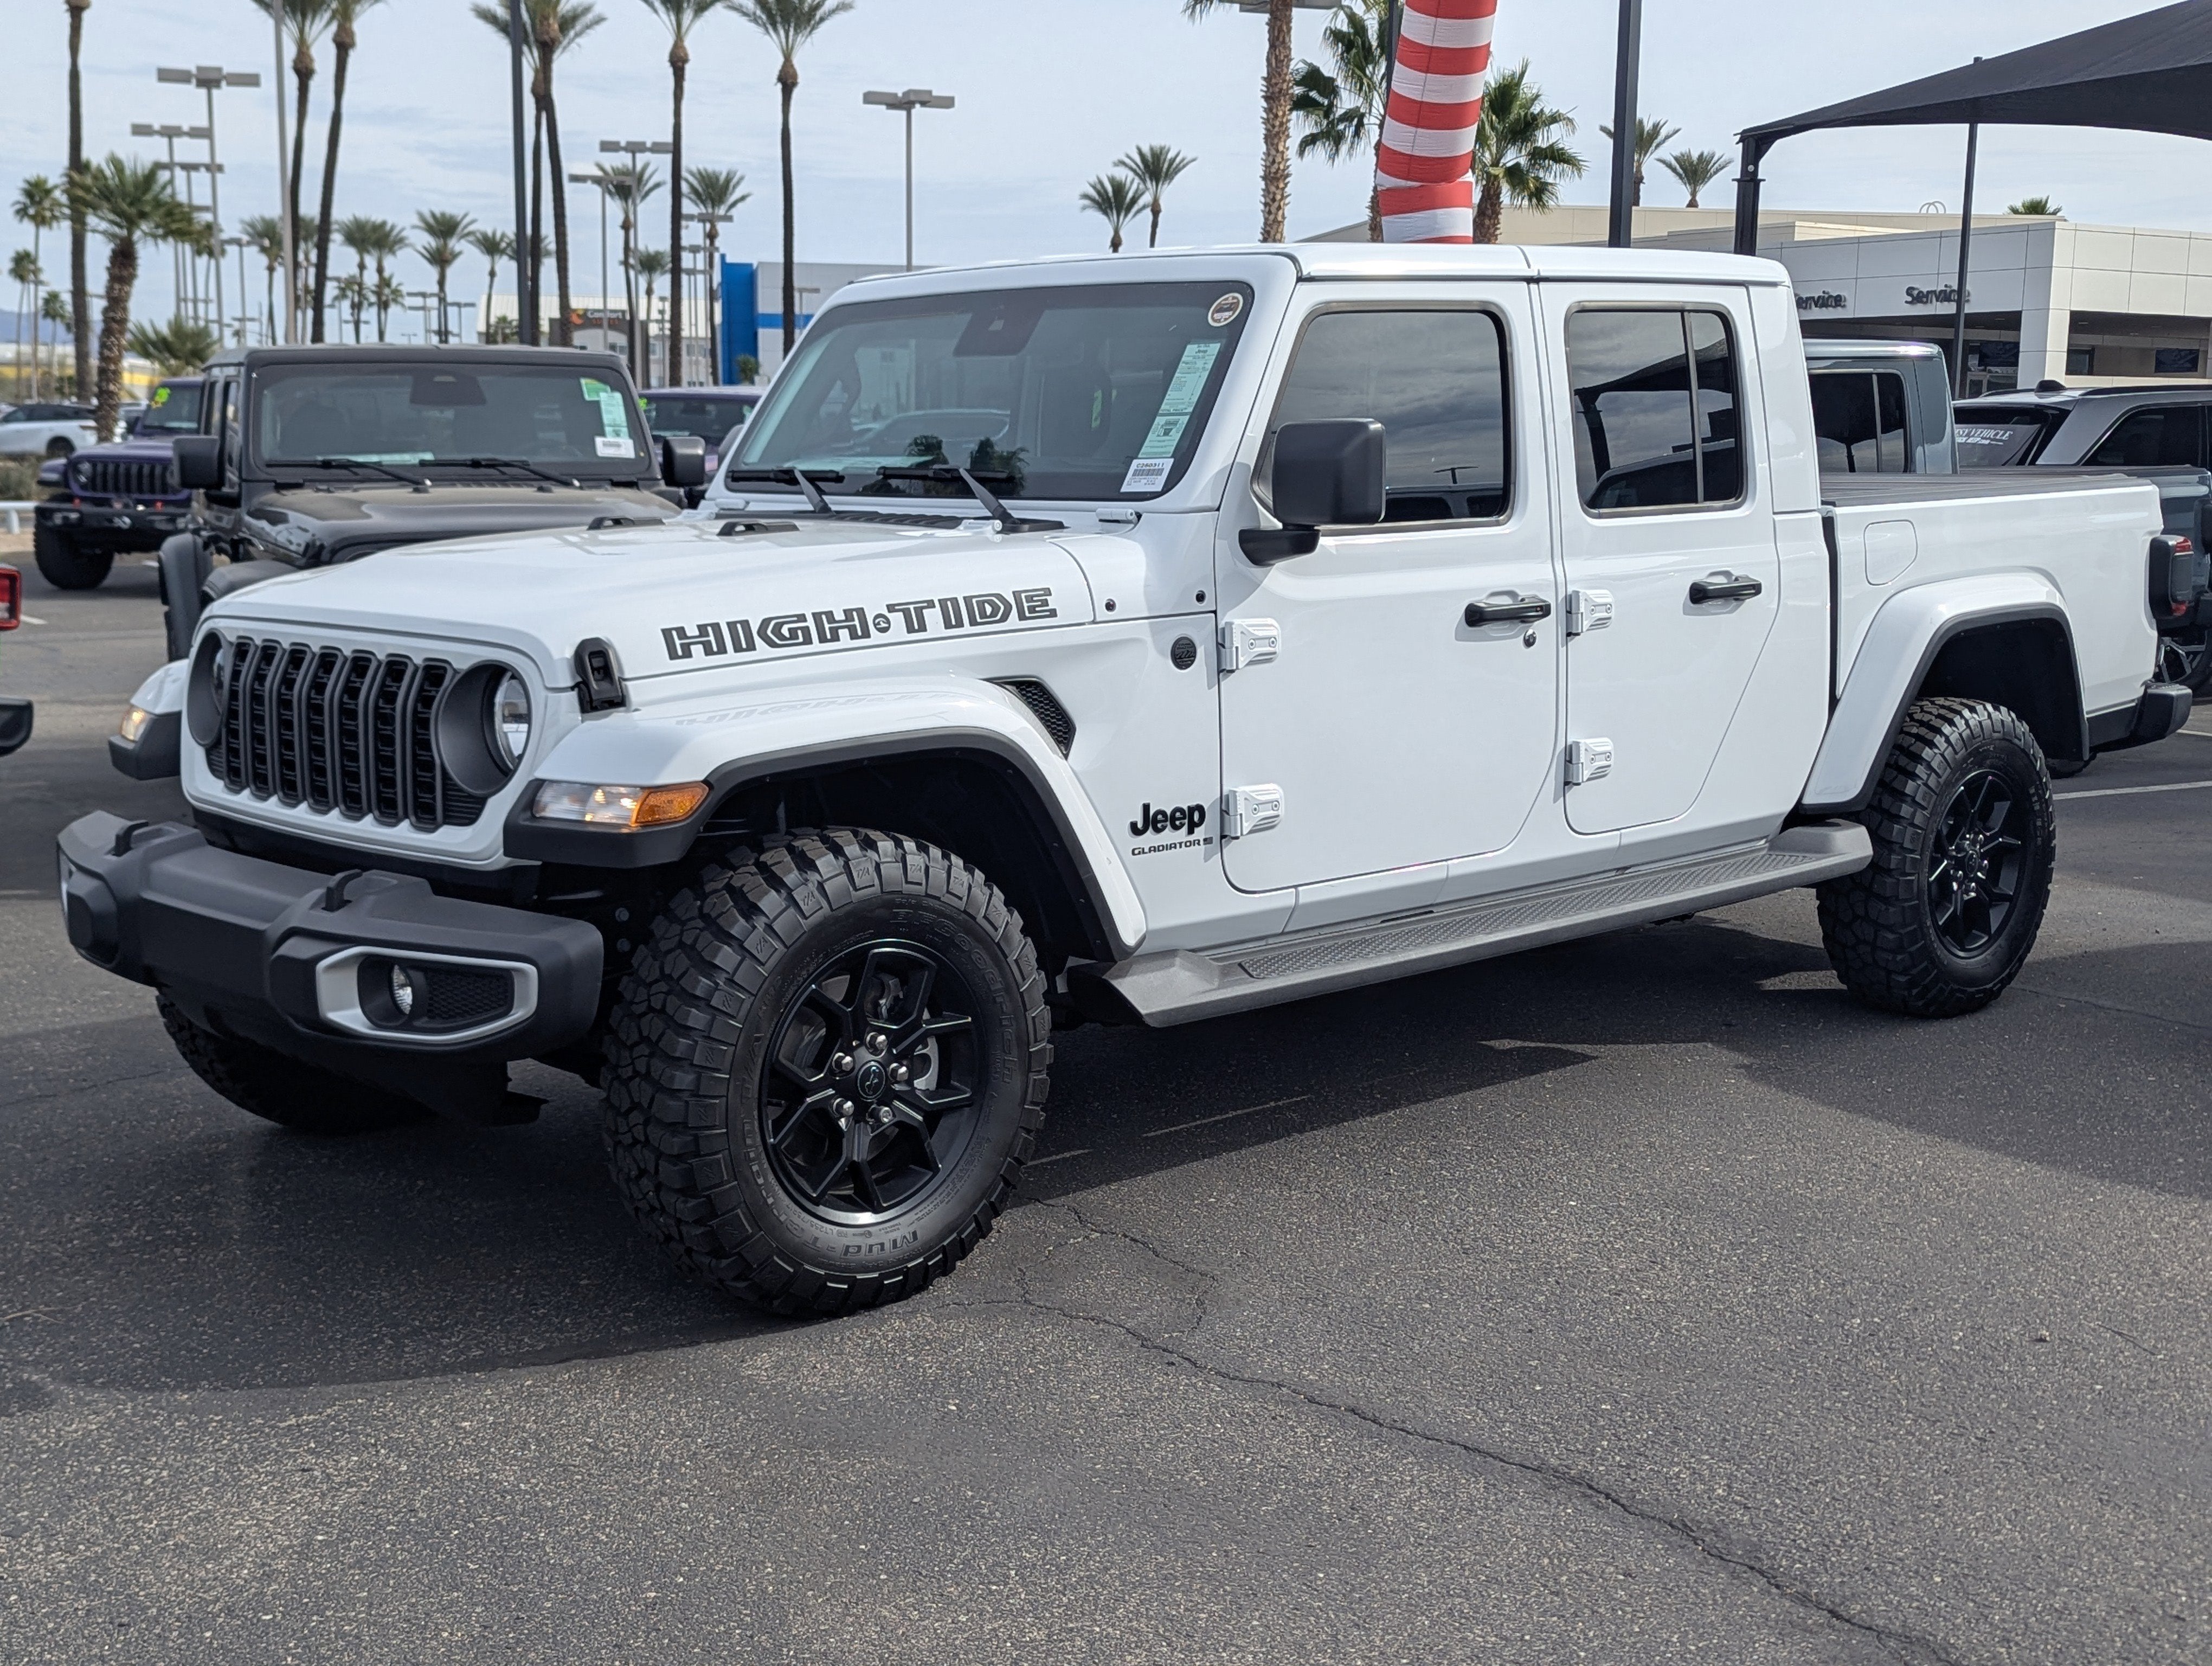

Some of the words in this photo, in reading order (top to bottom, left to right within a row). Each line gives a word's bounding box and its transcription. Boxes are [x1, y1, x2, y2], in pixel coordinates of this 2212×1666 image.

[1795, 290, 1846, 309] ervice
[661, 606, 871, 661] HIGH
[886, 587, 1058, 635] TIDE
[1129, 802, 1206, 836] Jeep
[1131, 839, 1201, 856] GLADIATOR
